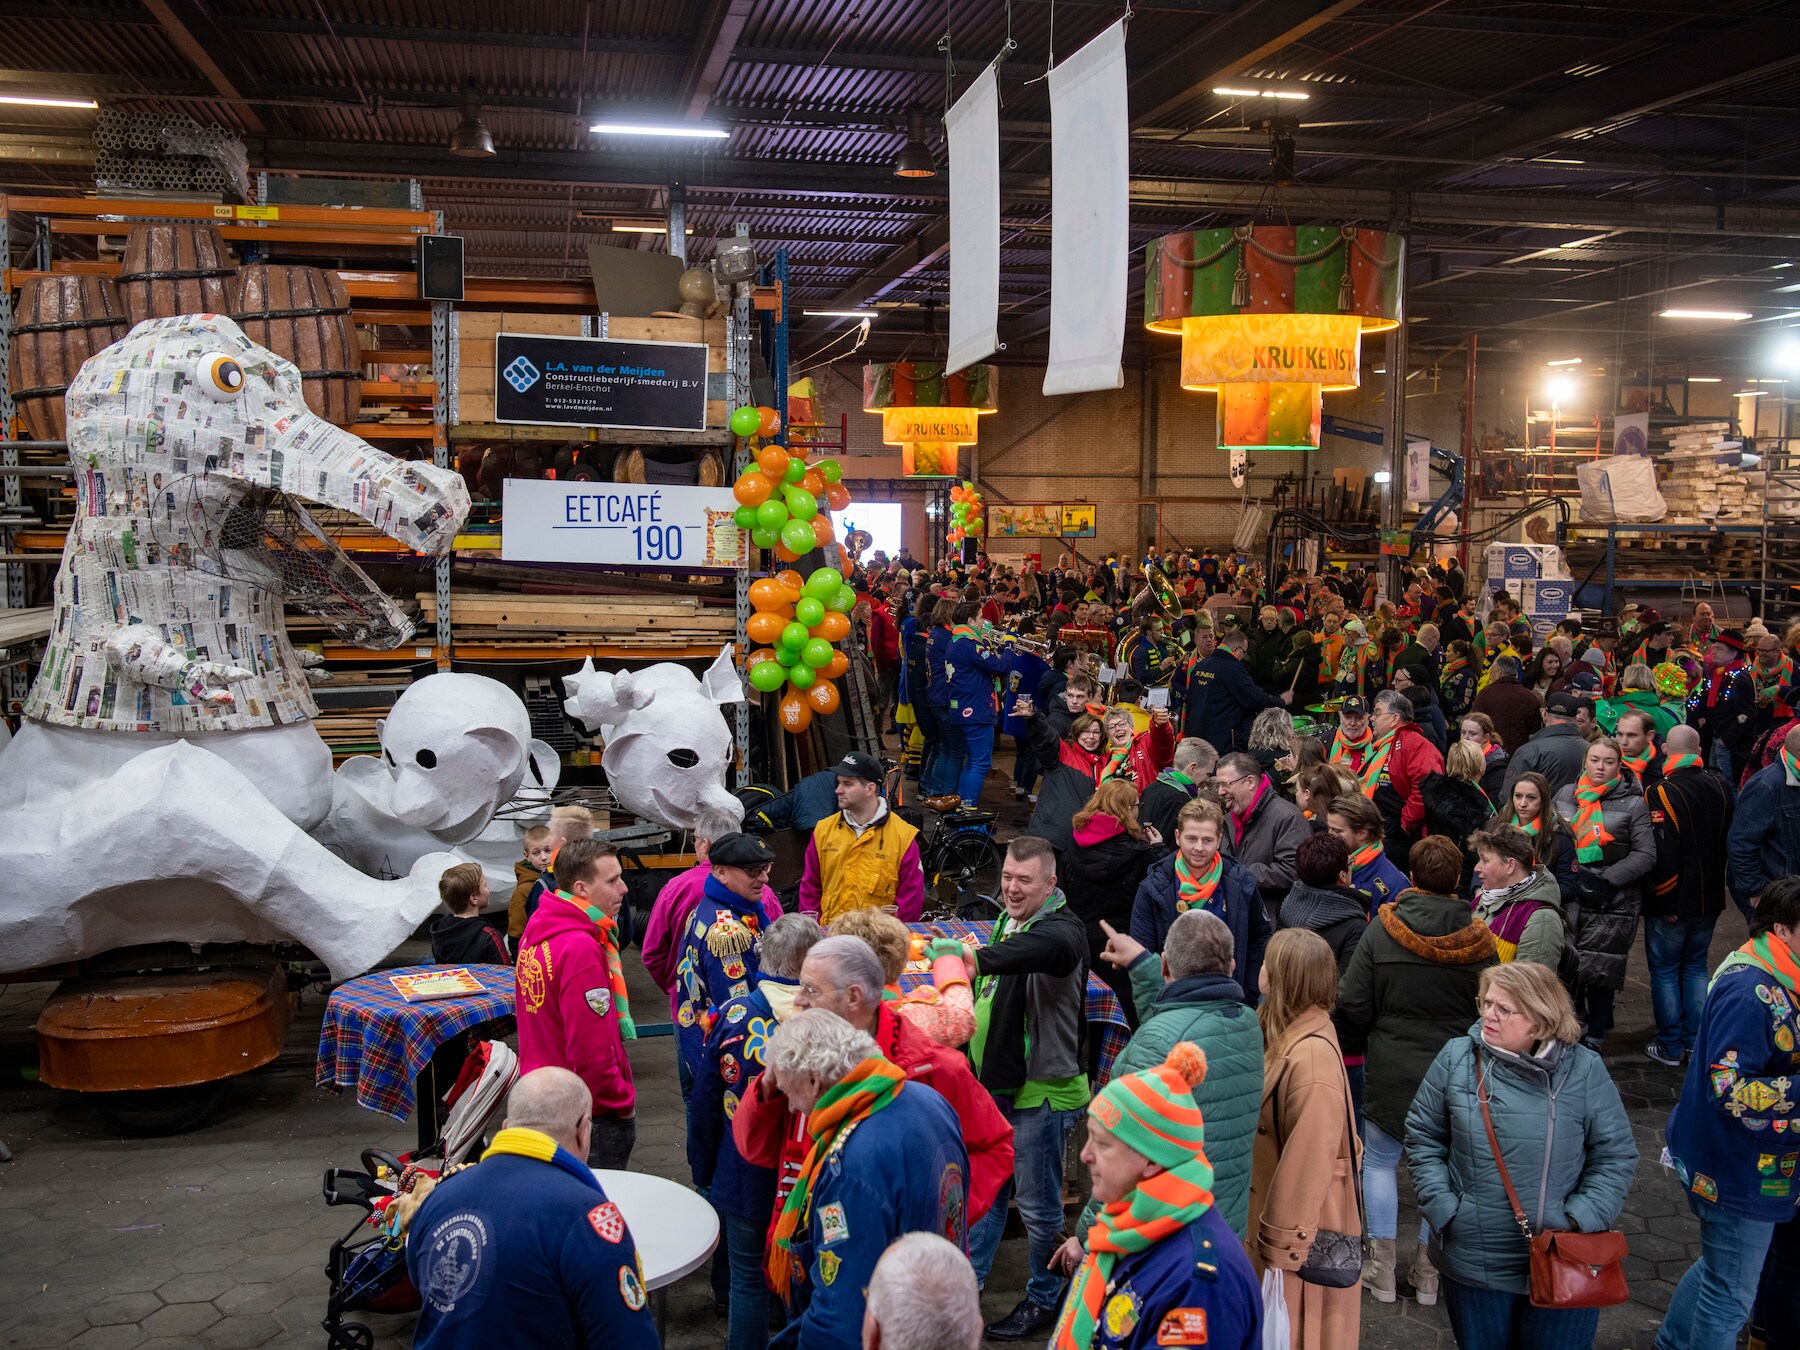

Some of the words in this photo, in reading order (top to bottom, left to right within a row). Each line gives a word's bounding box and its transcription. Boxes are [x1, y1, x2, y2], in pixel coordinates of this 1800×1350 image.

[545, 361, 568, 372] L.A.
[572, 364, 593, 373] van
[597, 365, 616, 374] der
[619, 365, 665, 378] Meijden
[545, 373, 679, 389] Constructiebedrijf-smederij
[545, 382, 611, 393] Berkel-Enschot
[545, 404, 613, 412] www.lavdmeijden.nl
[566, 490, 662, 522] EETCAFÉ
[632, 525, 682, 560] 190
